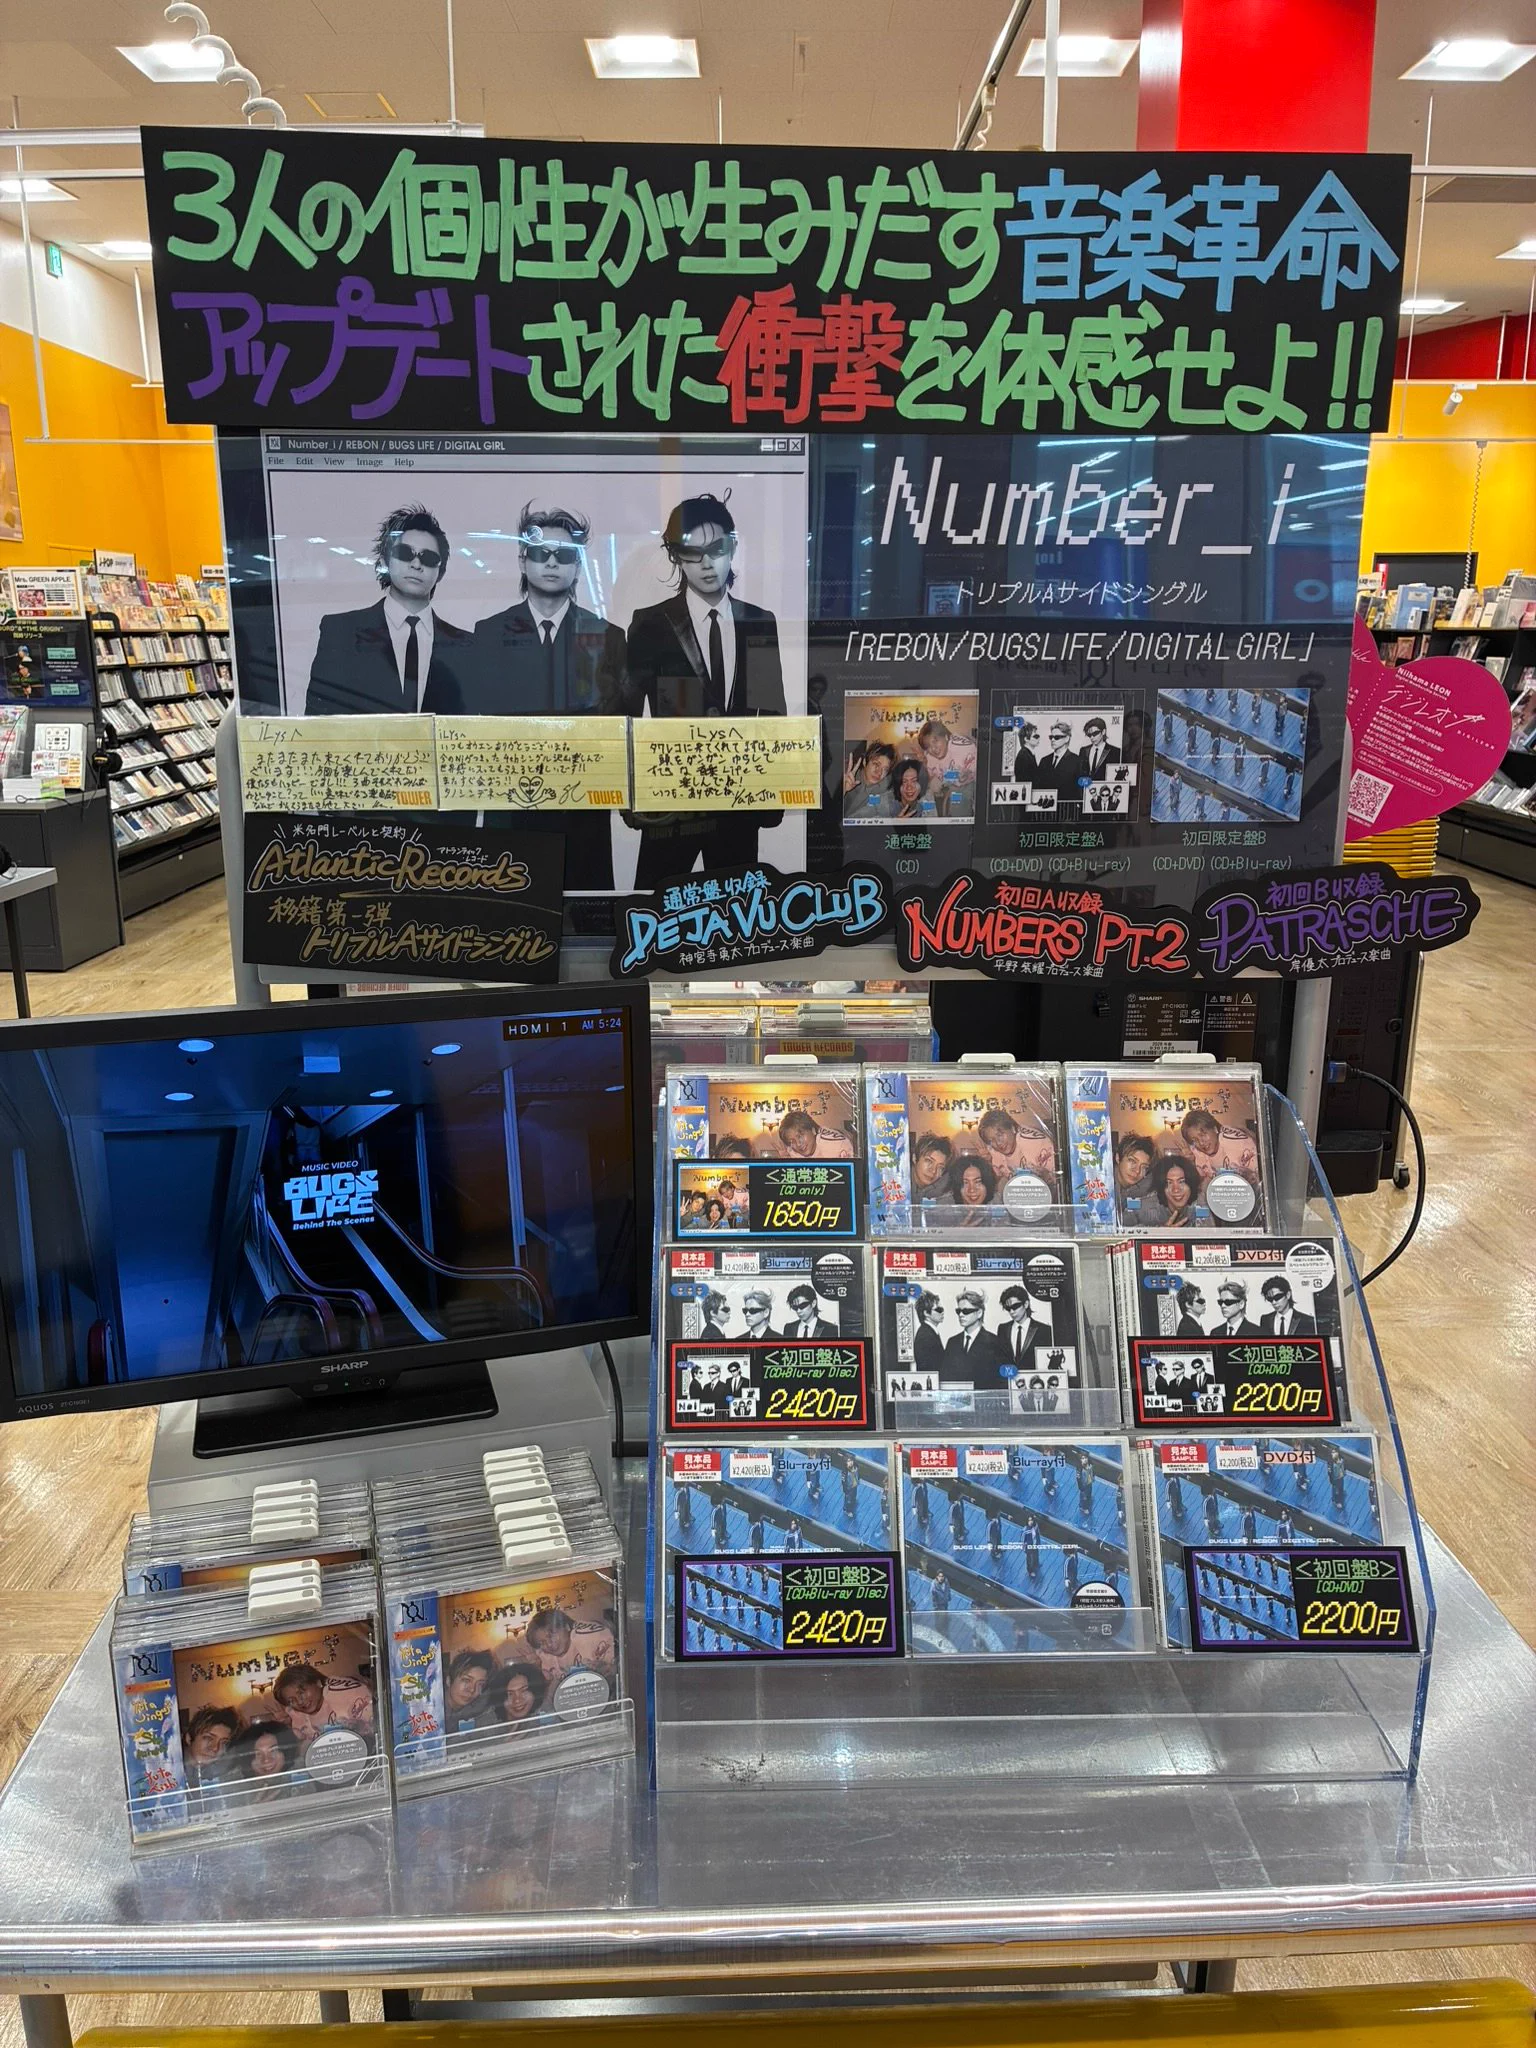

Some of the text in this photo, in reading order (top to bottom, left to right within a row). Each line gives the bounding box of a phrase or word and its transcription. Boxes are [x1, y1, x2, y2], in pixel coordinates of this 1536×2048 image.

[163, 148, 1399, 312] 3人の個性が生みだす音楽革命
[346, 440, 379, 450] REBON
[389, 440, 416, 450] BUGS
[417, 440, 434, 450] LIFE
[444, 440, 481, 451] DIGITAL
[484, 440, 505, 451] GIRL
[268, 457, 414, 467] File Edit View Image Help
[879, 456, 1295, 555] Number_i
[51, 575, 71, 583] APPLE
[955, 581, 1208, 605] トリプルAサイドシングル
[1430, 681, 1452, 697] LEON
[396, 791, 433, 806] TOWER
[587, 790, 624, 805] TOWER
[779, 790, 815, 805] TOWER
[884, 833, 933, 850] 通常盤
[1018, 831, 1105, 849] 初回限定盤A
[1182, 829, 1267, 848] 初回限定盤B
[895, 858, 920, 875] (CD)
[989, 856, 1131, 874] (CD+DVD) (CD+Blu-ray)
[1152, 854, 1293, 872] (CD+DVD) (CD+Blu-ray)
[780, 877, 887, 934] CLUB
[905, 878, 1084, 963] NUMBERS
[1200, 891, 1467, 970] PATRASCHE
[508, 1022, 549, 1036] HDMI
[582, 1019, 594, 1030] AM
[598, 1017, 621, 1029] 5:24
[782, 1041, 812, 1053] TOWER
[302, 1160, 359, 1172] MUSIC VIDEO
[283, 1169, 379, 1200] BUGS
[763, 1200, 841, 1228] 1650円
[293, 1216, 375, 1231] Behind The Scenes
[1236, 1249, 1284, 1262] DVD付
[321, 1360, 369, 1374] SHARP
[1248, 1363, 1291, 1376] [CD+DVD]
[764, 1388, 858, 1419] 2420円
[1232, 1382, 1323, 1413] 2200円
[17, 1402, 54, 1415] AQUOS
[777, 1458, 832, 1472] Blu-ray付
[1013, 1455, 1066, 1468] Blu-ray付
[1263, 1450, 1316, 1464] DVD付
[1316, 1579, 1365, 1594] [CD+DVD]
[786, 1609, 887, 1645] 2420円
[1302, 1601, 1401, 1636] 2200円
